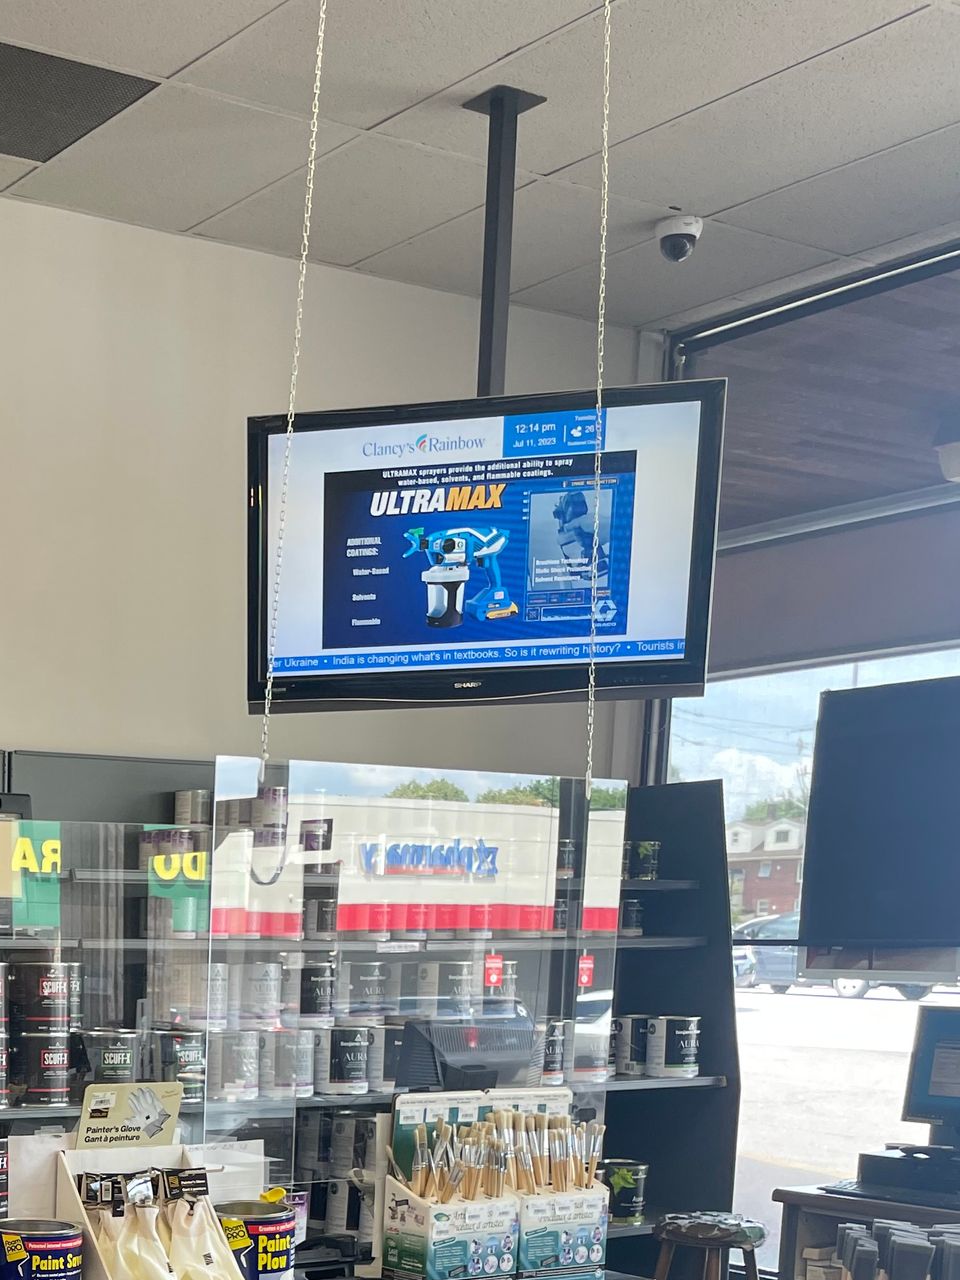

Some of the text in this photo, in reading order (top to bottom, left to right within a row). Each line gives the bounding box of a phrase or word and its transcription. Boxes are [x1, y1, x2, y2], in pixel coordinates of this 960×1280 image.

[516, 423, 556, 434] 12:14 pm
[362, 436, 485, 458] Clancy's Rainbow
[513, 438, 556, 448] Jul 11, 2023
[382, 457, 573, 478] ULTRAMAX sprayers provide the additional ability to spray
[398, 468, 553, 487] water-based, solvents, and flammable coatings.
[370, 484, 506, 517] ULTRAMAX
[284, 657, 318, 668] Ukraine
[332, 655, 354, 665] India
[357, 654, 364, 664] is
[367, 653, 406, 667] changing
[411, 651, 440, 662] what's
[443, 650, 451, 660] in
[454, 646, 501, 659] textbooks.
[504, 645, 517, 657] So
[520, 645, 527, 656] is
[530, 644, 537, 655] it
[539, 643, 579, 657] rewriting
[637, 638, 674, 651] Tourists
[454, 681, 481, 689] SHARP
[42, 981, 67, 995] SCUFF-X
[679, 1039, 700, 1049] AURA
[43, 1052, 68, 1066] SCUFF-X
[104, 1052, 132, 1066] SCUFF-X
[345, 1053, 368, 1062] AURA
[86, 1125, 141, 1134] Painter's Glove
[84, 1135, 103, 1143] Gant
[110, 1134, 140, 1143] peinture
[227, 1230, 245, 1241] PRO
[8, 1244, 23, 1253] PRO
[258, 1234, 290, 1252] Paint
[32, 1255, 64, 1270] Paint
[258, 1253, 287, 1270] Plow
